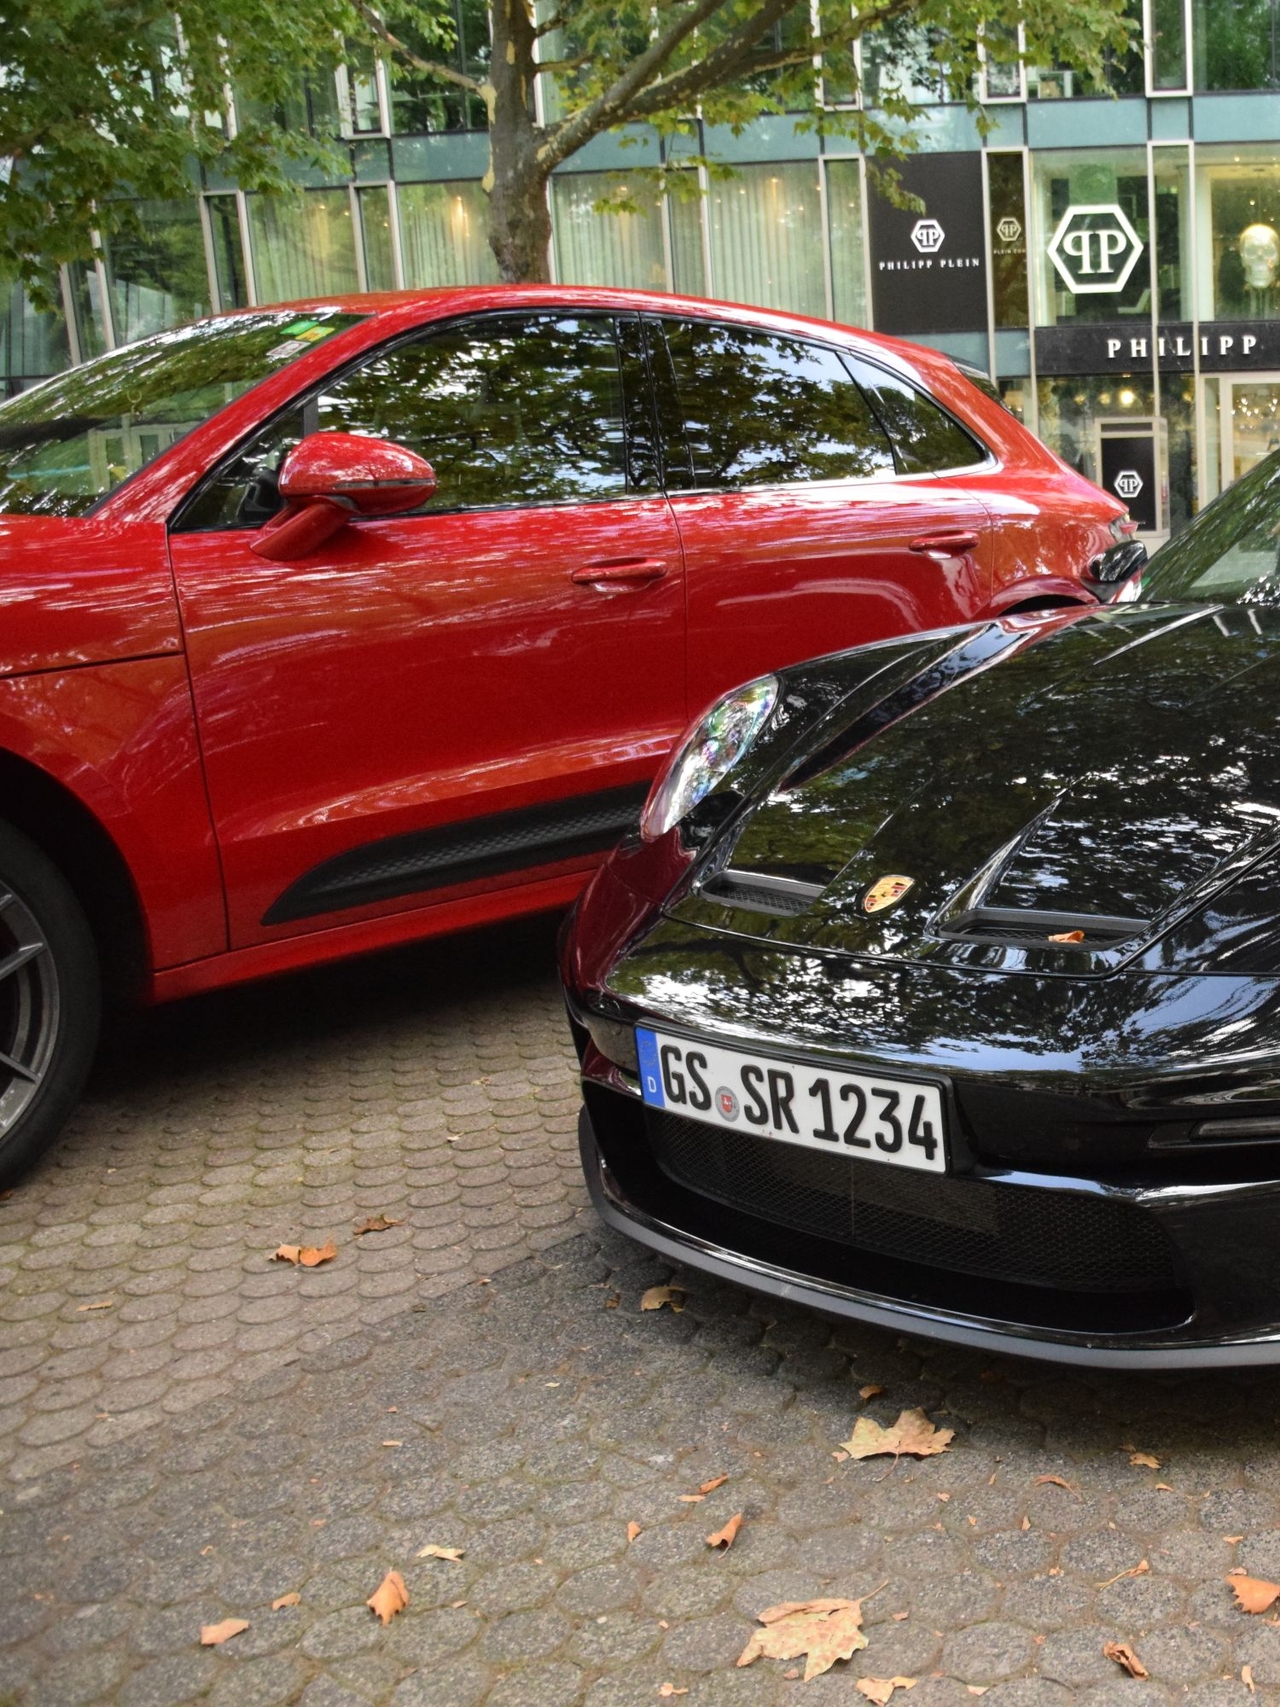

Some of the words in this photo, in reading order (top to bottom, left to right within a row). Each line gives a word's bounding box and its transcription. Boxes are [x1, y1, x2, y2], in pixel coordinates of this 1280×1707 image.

[879, 259, 933, 270] PHILIPP
[940, 257, 980, 268] PLEIN
[1107, 336, 1258, 359] PHILIPP
[648, 1076, 657, 1093] D
[660, 1044, 712, 1111] GS
[740, 1064, 800, 1134] SR
[809, 1077, 938, 1161] 1234
